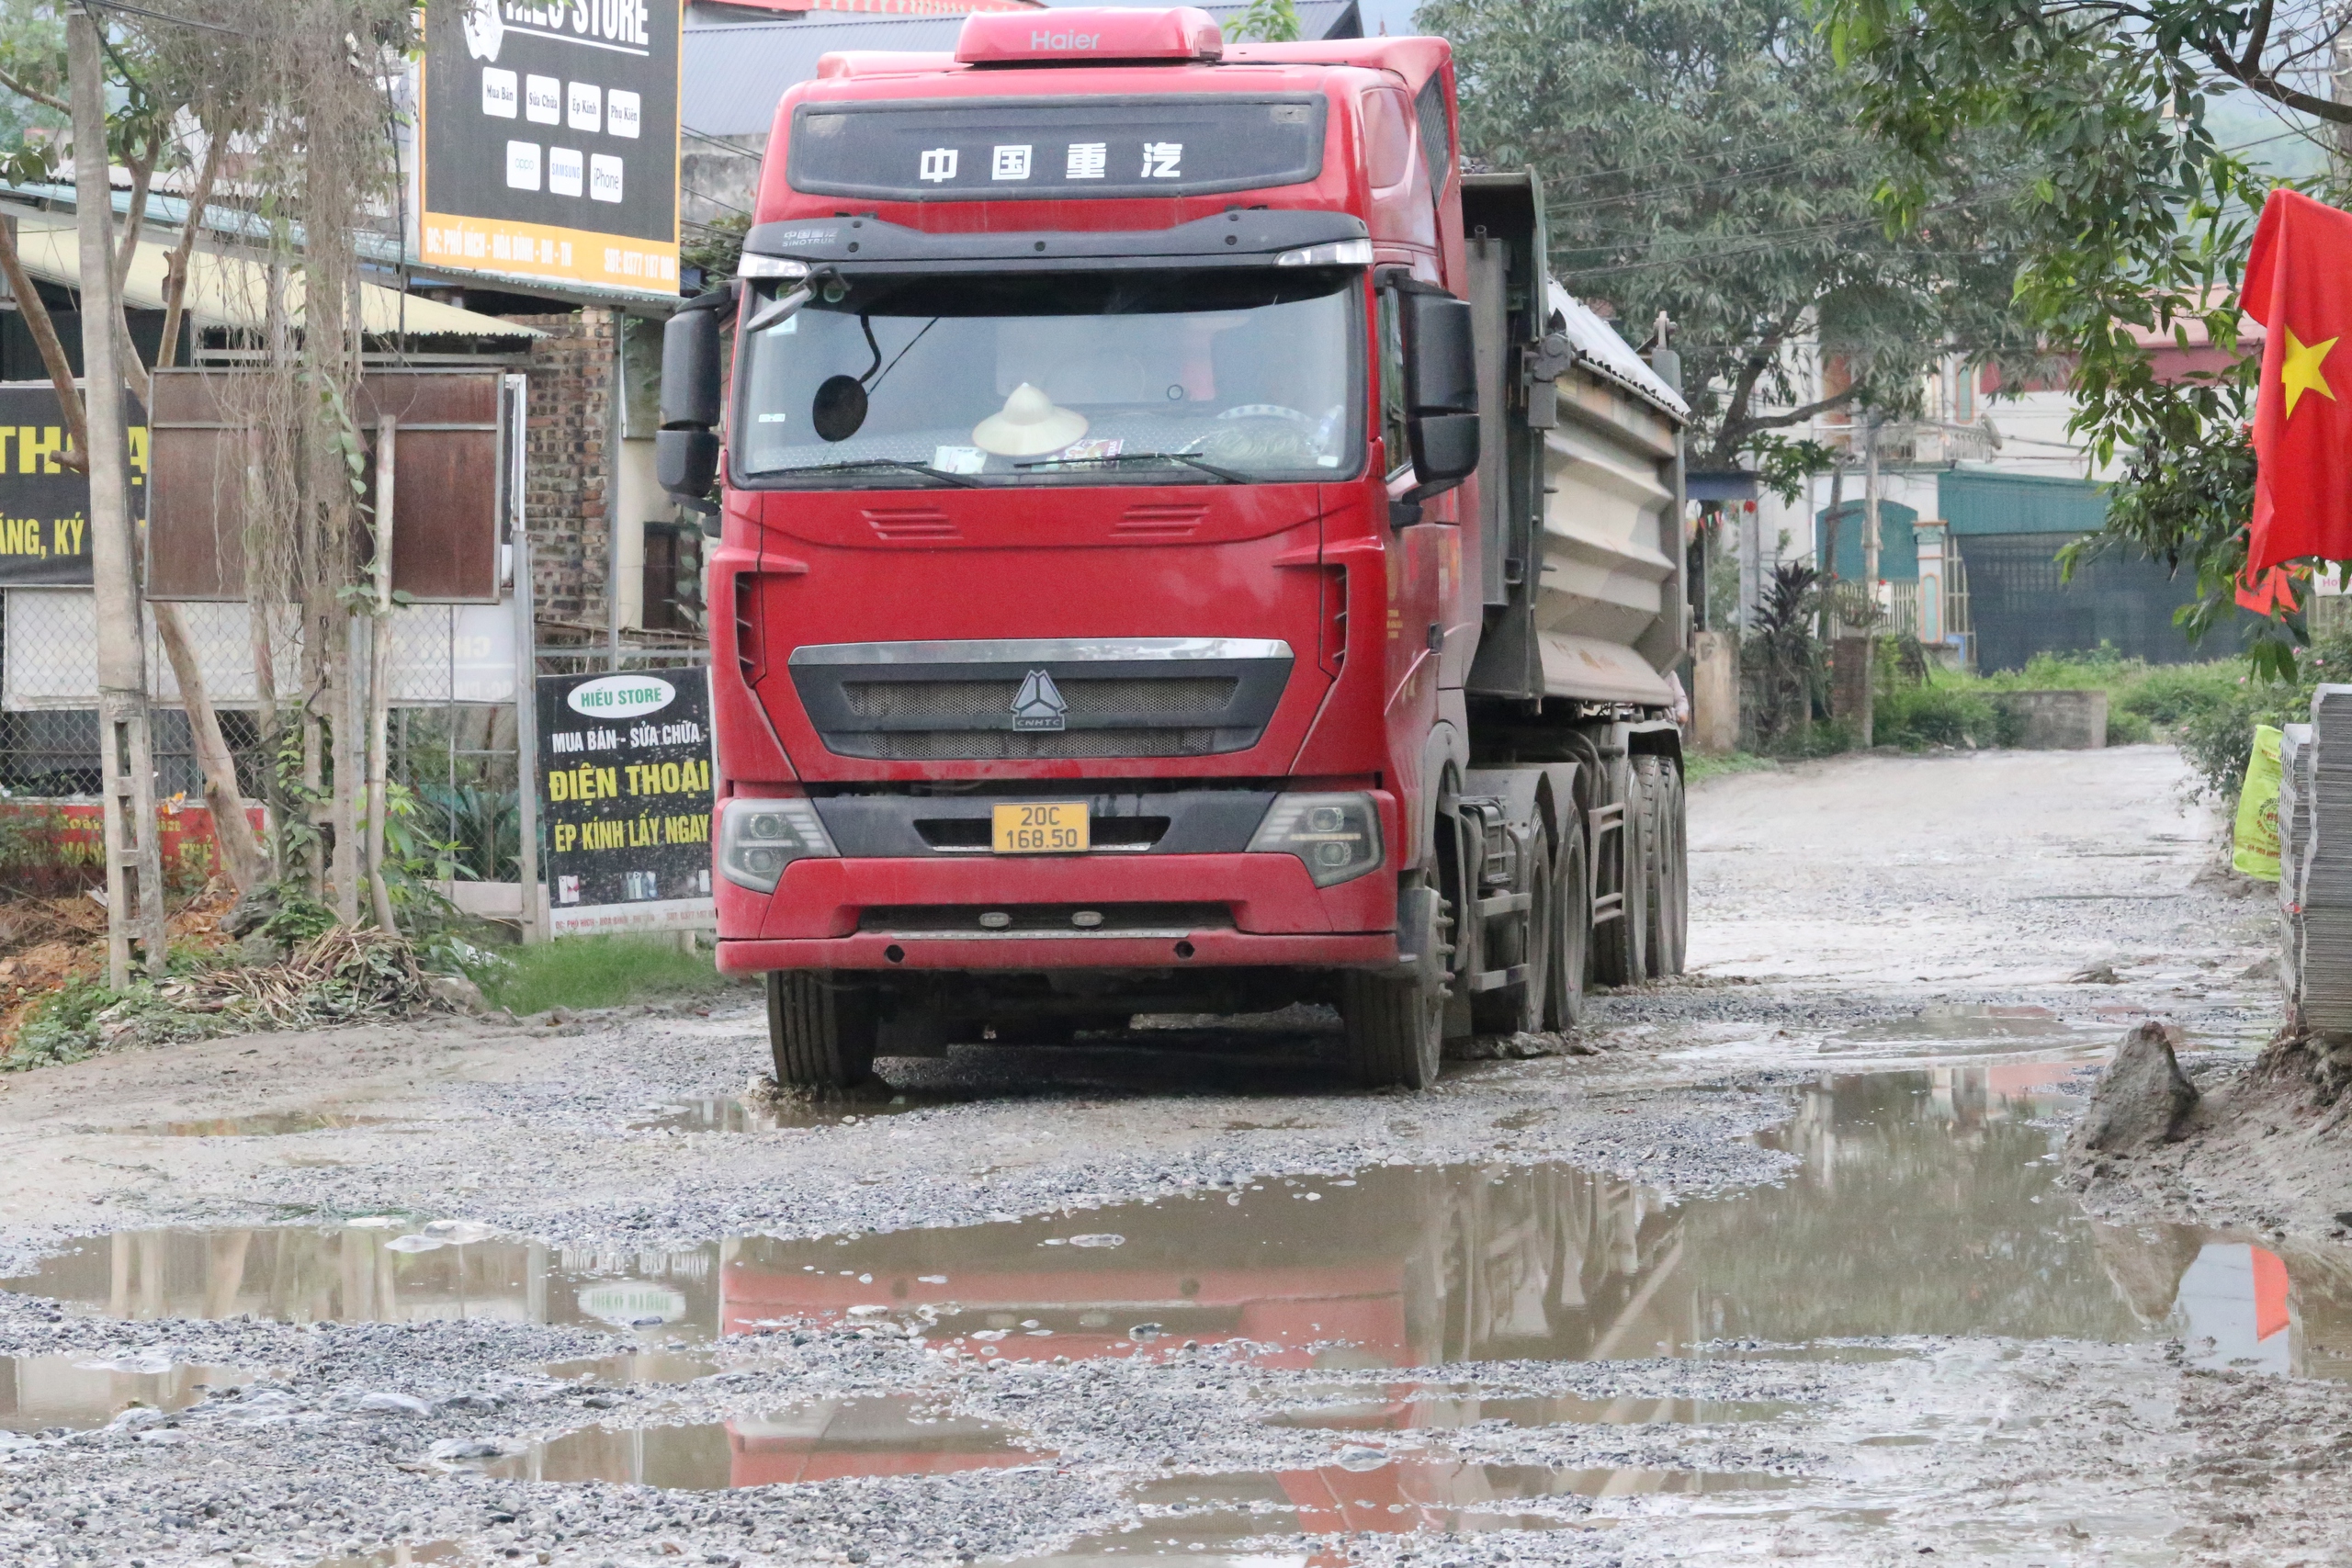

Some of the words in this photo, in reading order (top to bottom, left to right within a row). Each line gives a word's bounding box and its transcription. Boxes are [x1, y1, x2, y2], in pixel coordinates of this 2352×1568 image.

[1031, 28, 1101, 50] Haier
[486, 84, 499, 99] Mua
[502, 86, 514, 101] Bán
[572, 95, 580, 114] Ép
[582, 100, 596, 115] Kính
[610, 105, 622, 123] Phụ
[551, 163, 581, 179] SAMSUNG
[920, 141, 1182, 183] 中国重汽
[594, 167, 619, 189] iPhone
[782, 238, 835, 247] SINOTRUK
[54, 512, 85, 555] KÝ
[581, 687, 614, 707] HIẾU
[618, 687, 662, 705] STORE
[552, 731, 583, 753] MUA
[587, 726, 617, 751] BÁN
[630, 720, 661, 748] SỬA
[662, 720, 701, 745] CHỮA
[548, 762, 618, 806] ĐIỆN
[625, 760, 709, 798] THOẠI
[1021, 807, 1060, 826] 20C
[554, 818, 577, 852] ÉP
[582, 816, 625, 851] KÍNH
[628, 808, 660, 847] LẤY
[664, 814, 709, 844] NGAY
[1007, 829, 1078, 849] 168.50
